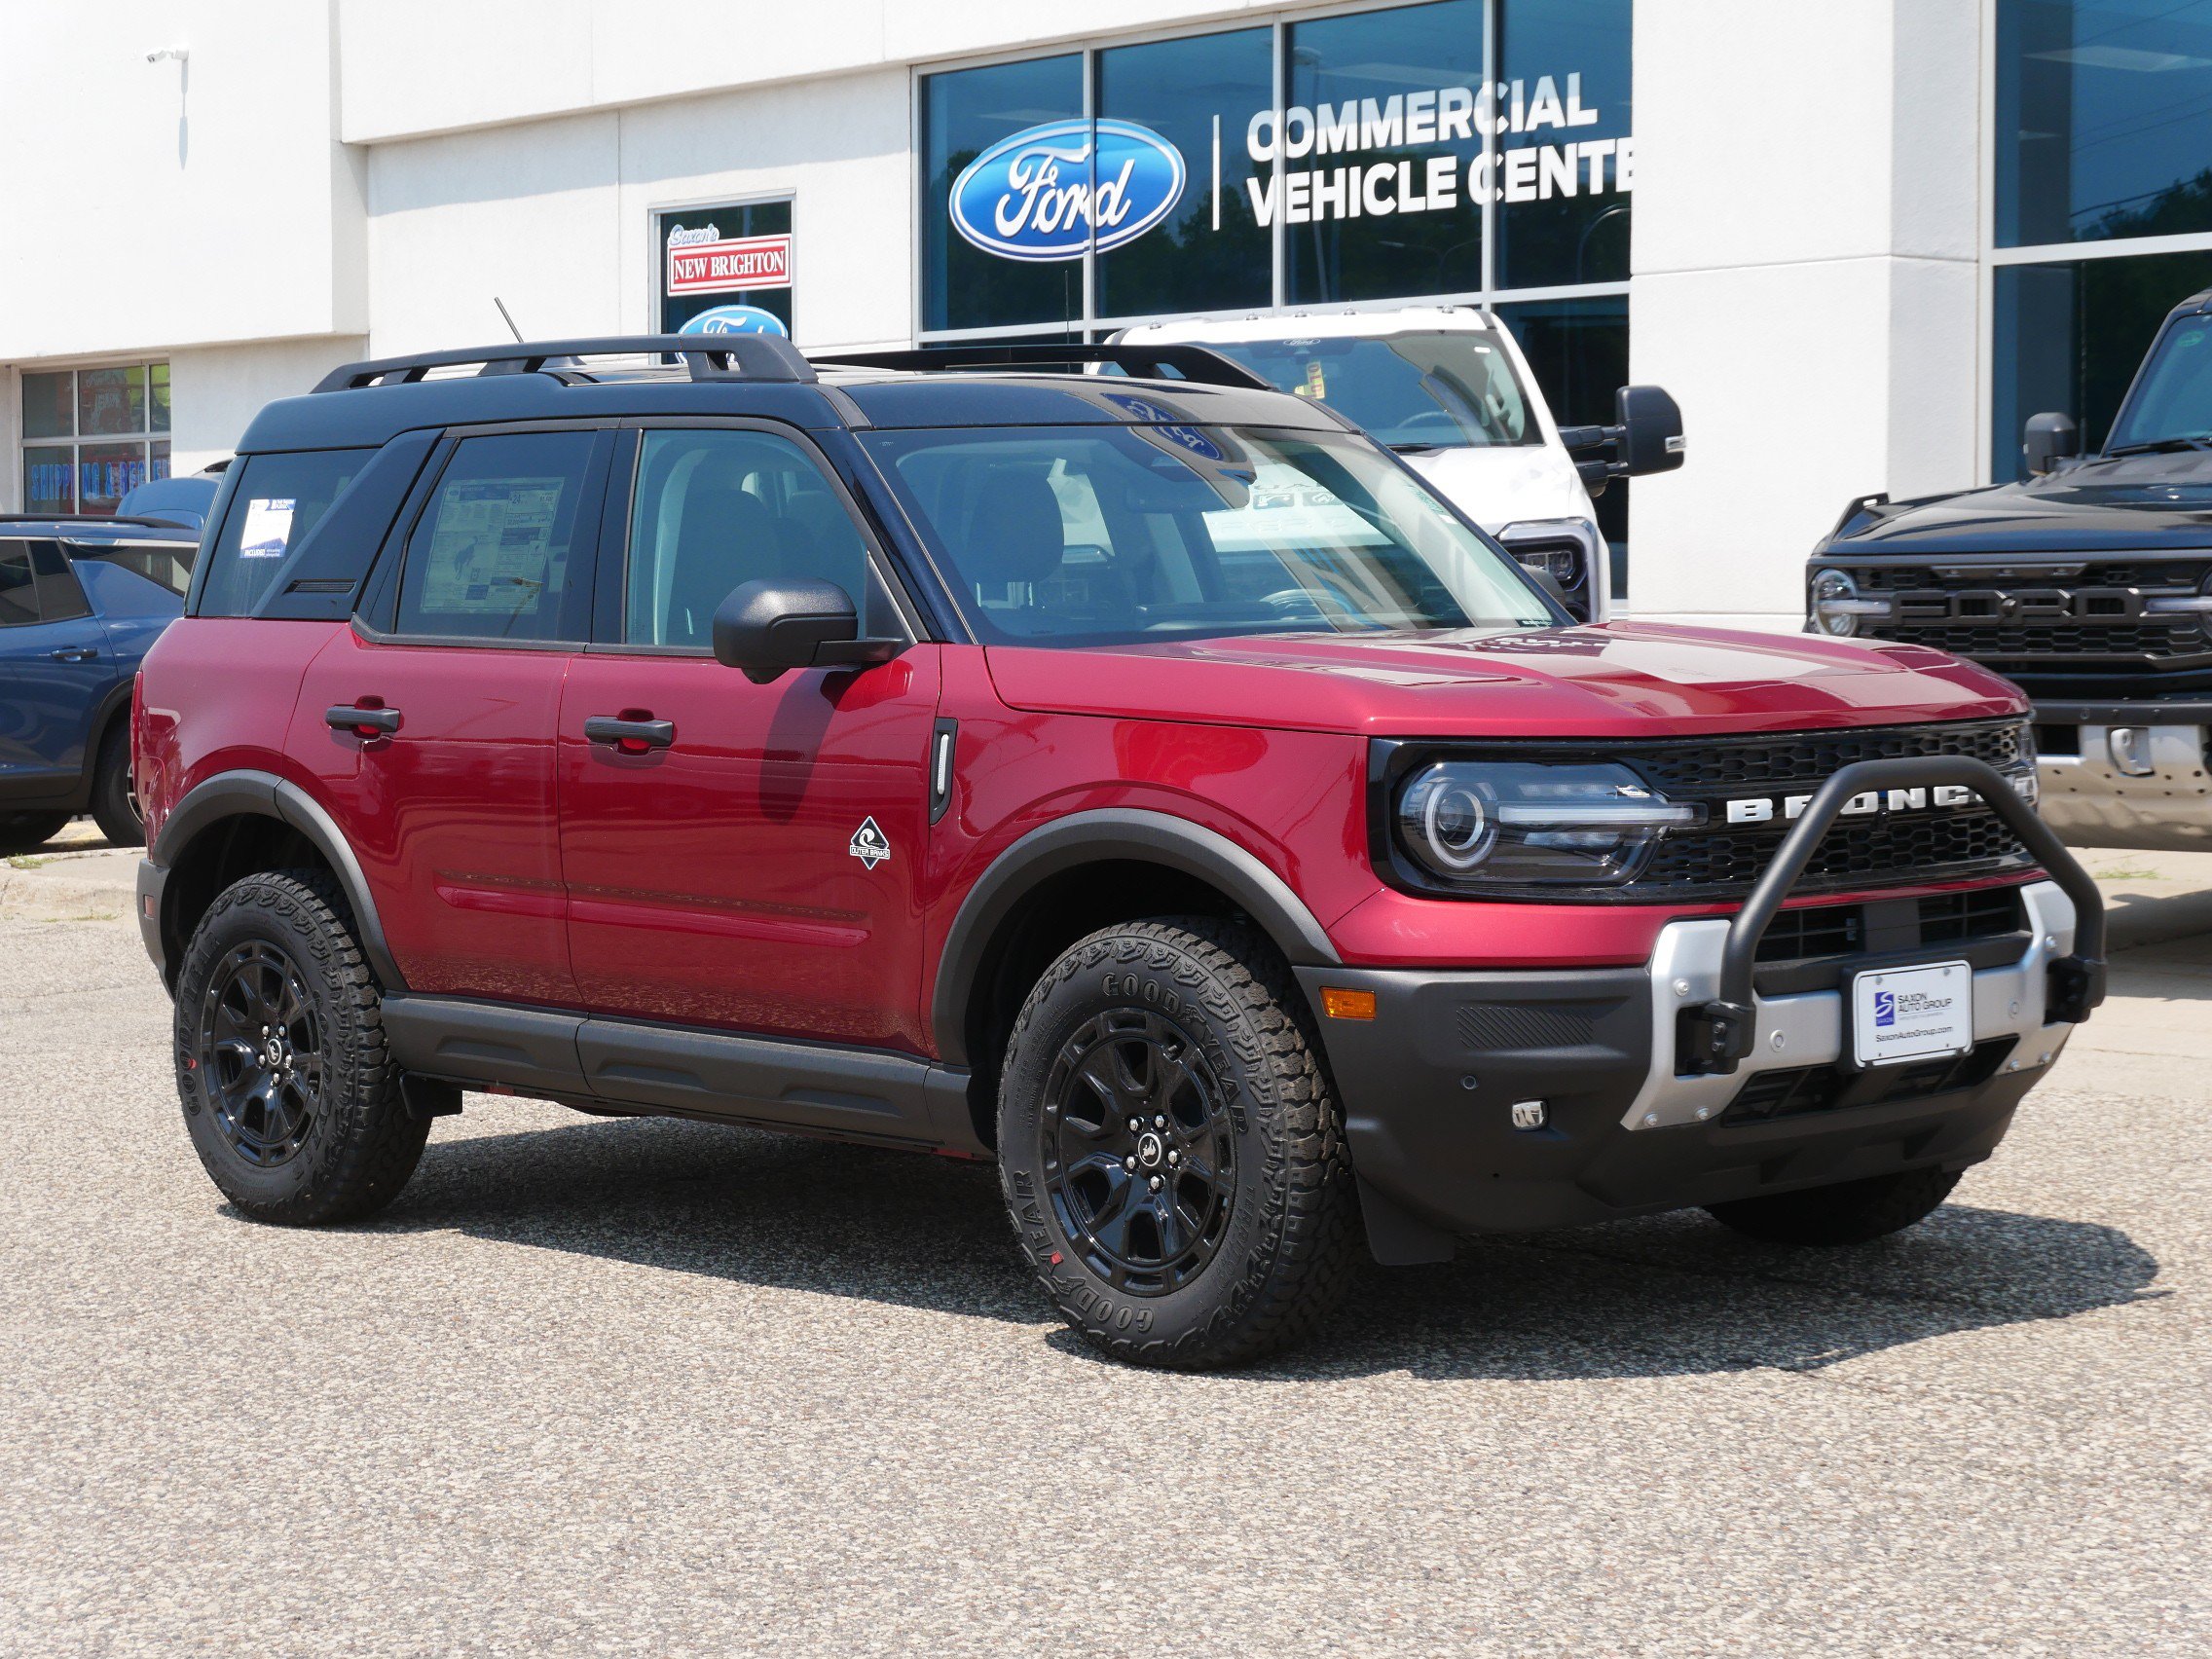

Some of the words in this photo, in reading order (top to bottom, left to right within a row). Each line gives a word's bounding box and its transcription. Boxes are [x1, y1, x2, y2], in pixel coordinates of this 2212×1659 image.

[1246, 72, 1599, 163] COMMERCIAL
[994, 142, 1135, 238] Ford
[1246, 154, 1457, 227] VEHICLE
[669, 224, 719, 245] Saxon's
[674, 257, 707, 280] NEW
[710, 250, 785, 277] BRIGHTON
[32, 461, 100, 500] SHIPPING
[1892, 587, 2144, 625] FORD
[852, 847, 868, 856] OUTER
[1898, 993, 1927, 1005] SAXON
[1898, 1002, 1920, 1013] AUTO
[1923, 998, 1953, 1010] GROUP
[1876, 1027, 1953, 1042] SaxonAutoGroup.com
